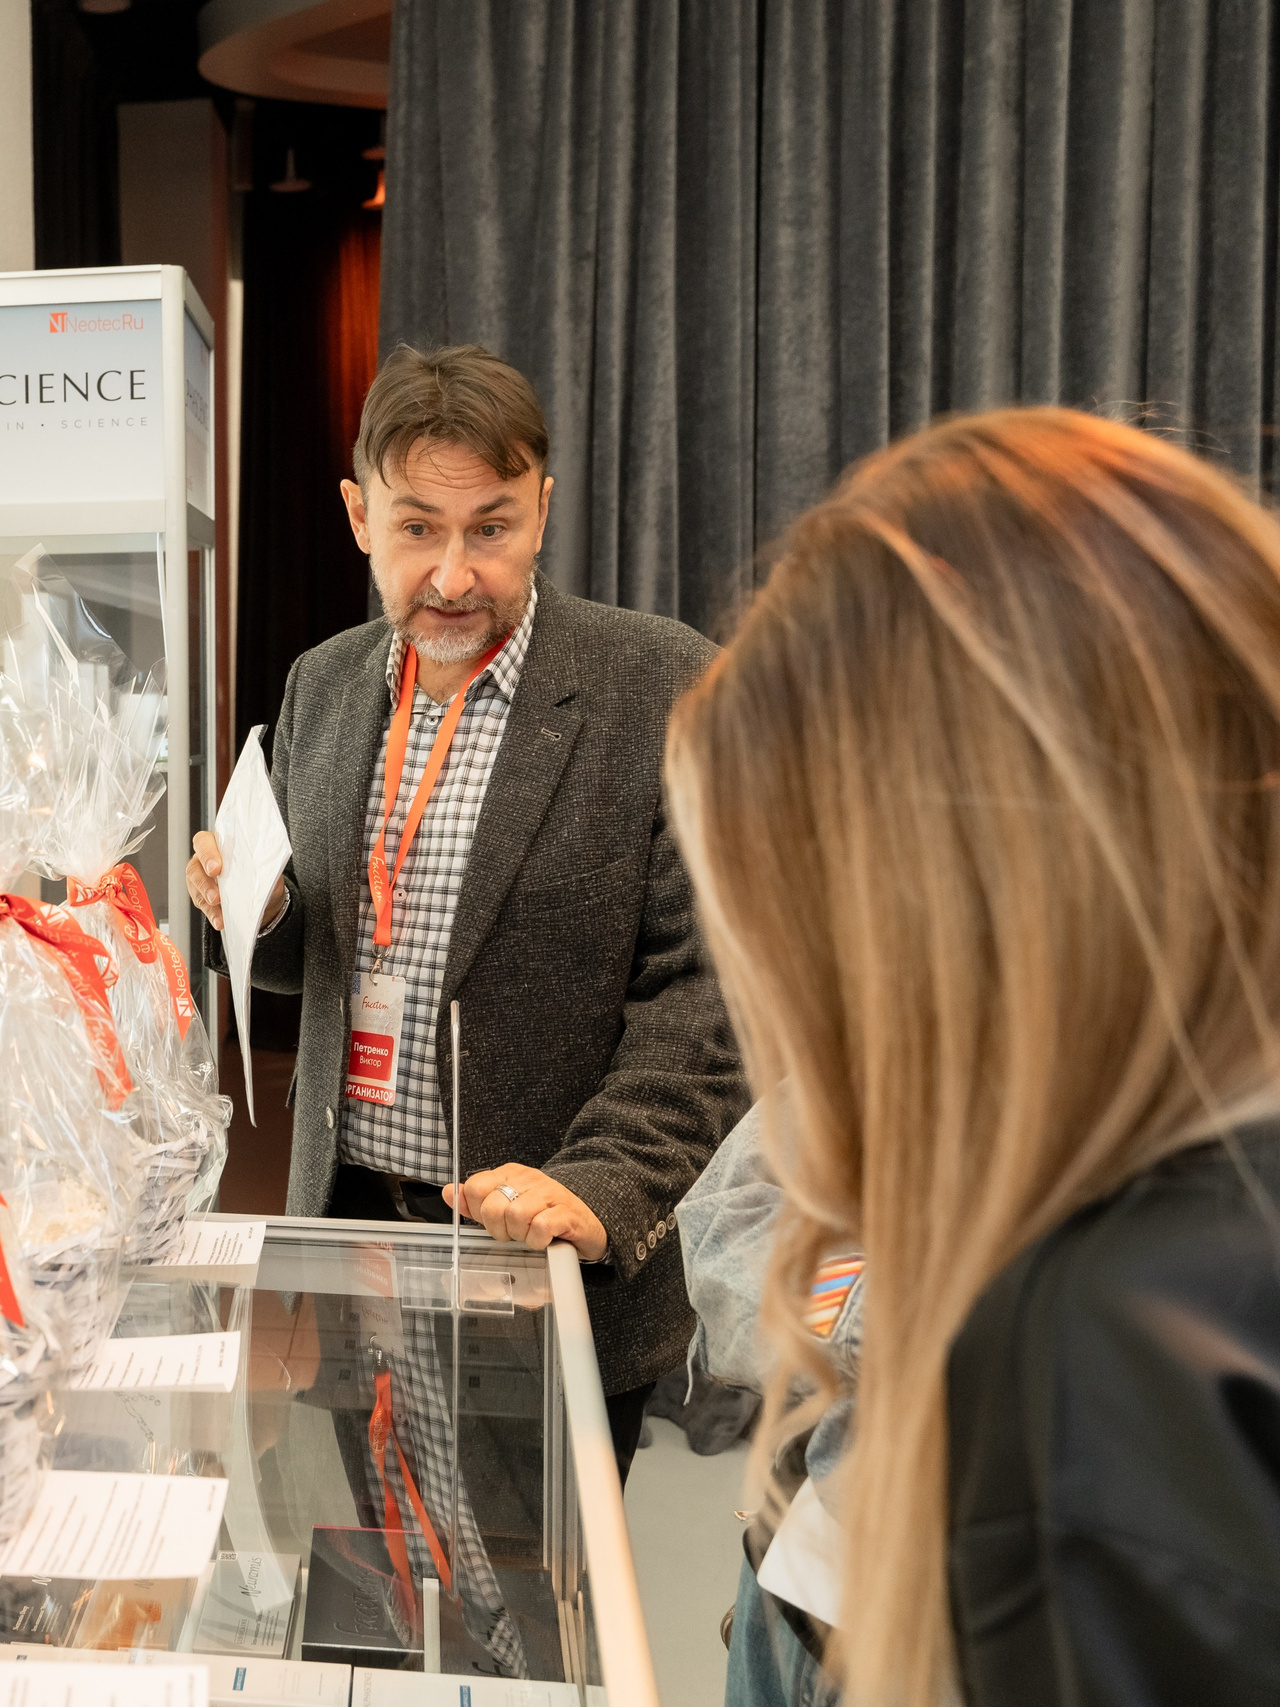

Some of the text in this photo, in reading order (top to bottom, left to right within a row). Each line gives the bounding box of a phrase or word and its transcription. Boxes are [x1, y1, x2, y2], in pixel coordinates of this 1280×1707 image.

[61, 416, 149, 430] SCIENCE
[353, 1041, 389, 1057] Петренко
[359, 1055, 382, 1068] Виктор
